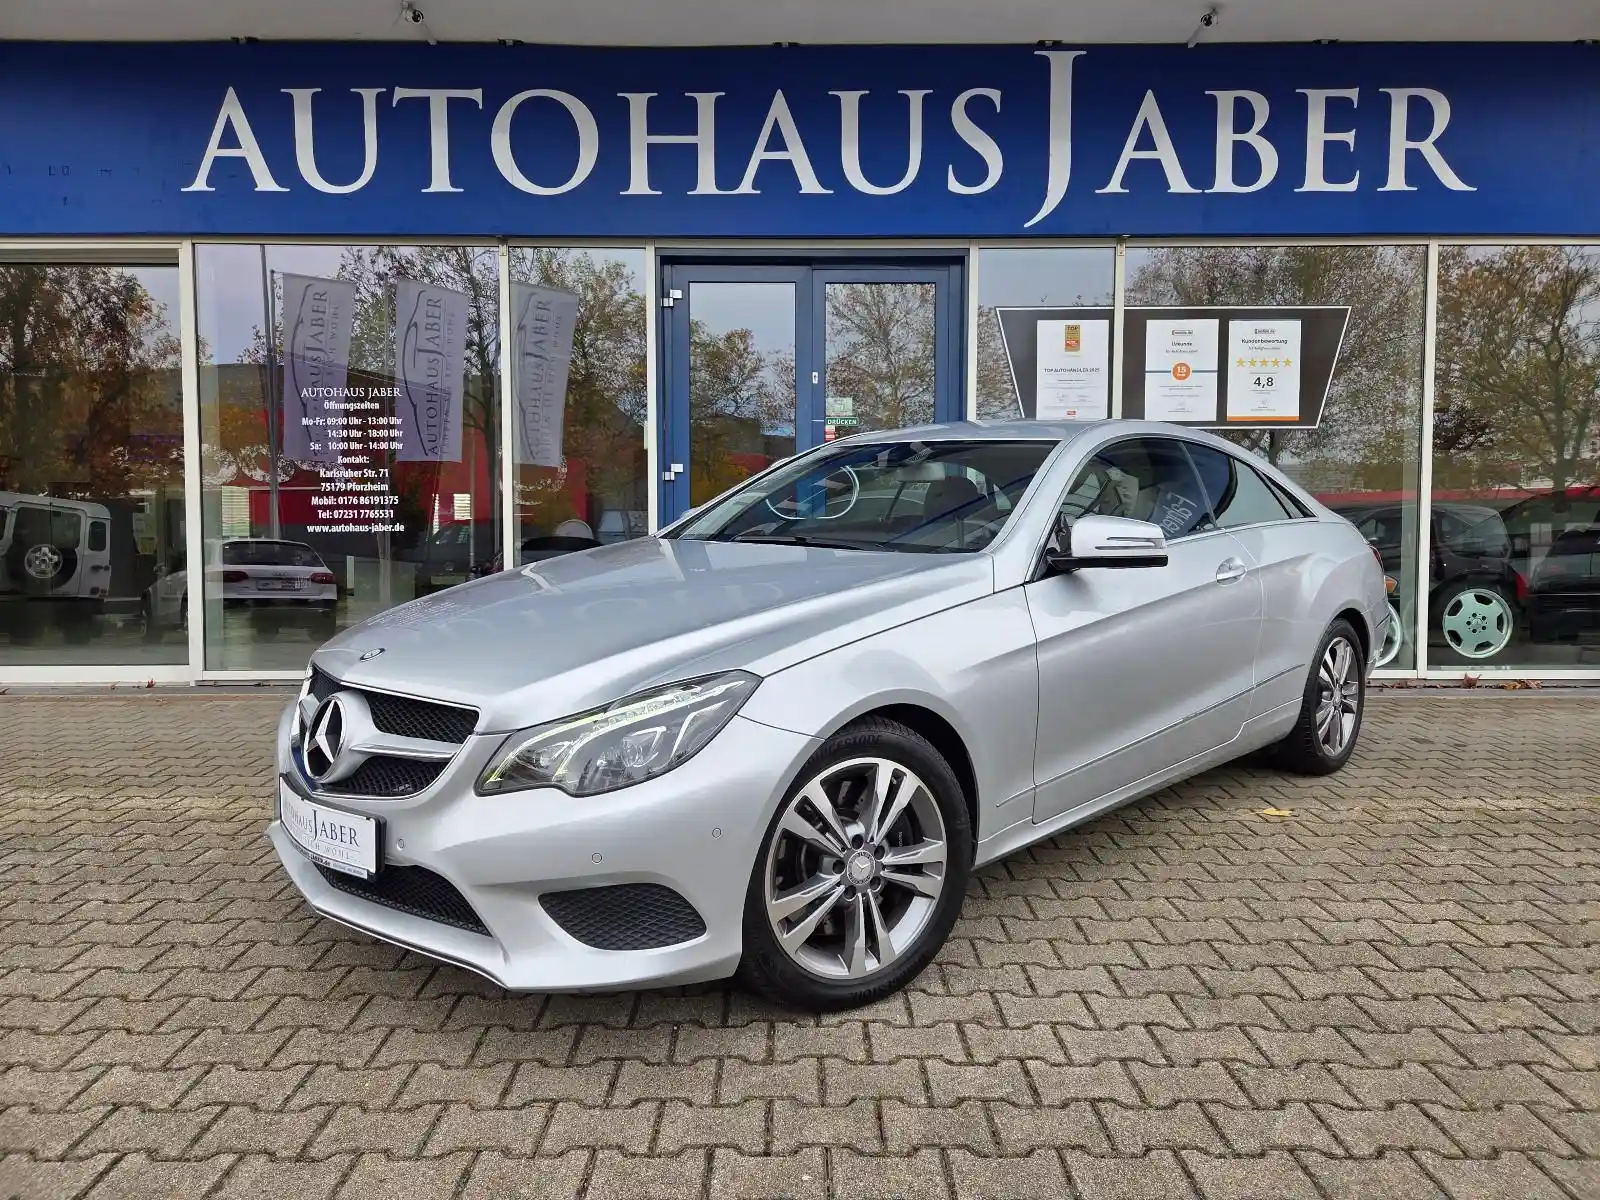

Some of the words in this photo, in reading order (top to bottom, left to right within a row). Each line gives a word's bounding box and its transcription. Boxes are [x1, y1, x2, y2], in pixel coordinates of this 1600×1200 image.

[1253, 377, 1274, 389] 4,8
[300, 387, 365, 398] AUTOHAUS
[368, 387, 403, 399] JABER
[324, 400, 380, 412] Öffnungszeiten
[301, 417, 326, 426] Mo-Fr:
[326, 417, 347, 426] 09:00
[348, 417, 363, 426] Uhr
[367, 417, 388, 426] 13:00
[389, 417, 403, 426] Uhr
[327, 429, 348, 438] 14:30
[349, 429, 363, 438] Uhr
[368, 429, 388, 438] 18:00
[389, 429, 403, 438] Uhr
[310, 441, 322, 450] Sa:
[328, 441, 348, 450] 10:00
[349, 441, 363, 450] Uhr
[369, 441, 388, 450] 14:00
[389, 441, 404, 450] Uhr
[337, 455, 370, 464] Kontakt:
[319, 468, 363, 478] Karlsruher
[363, 468, 378, 478] Str.
[379, 468, 389, 478] 71
[320, 482, 346, 492] 75179
[346, 482, 389, 492] Pforzheim
[311, 495, 337, 505] Mobil:
[338, 495, 358, 505] 0176
[359, 495, 399, 505] 86191375
[317, 509, 333, 519] Tel:
[333, 509, 358, 519] 07231
[360, 509, 394, 519] 7765531
[306, 522, 405, 533] www.autohaus-jaber.de
